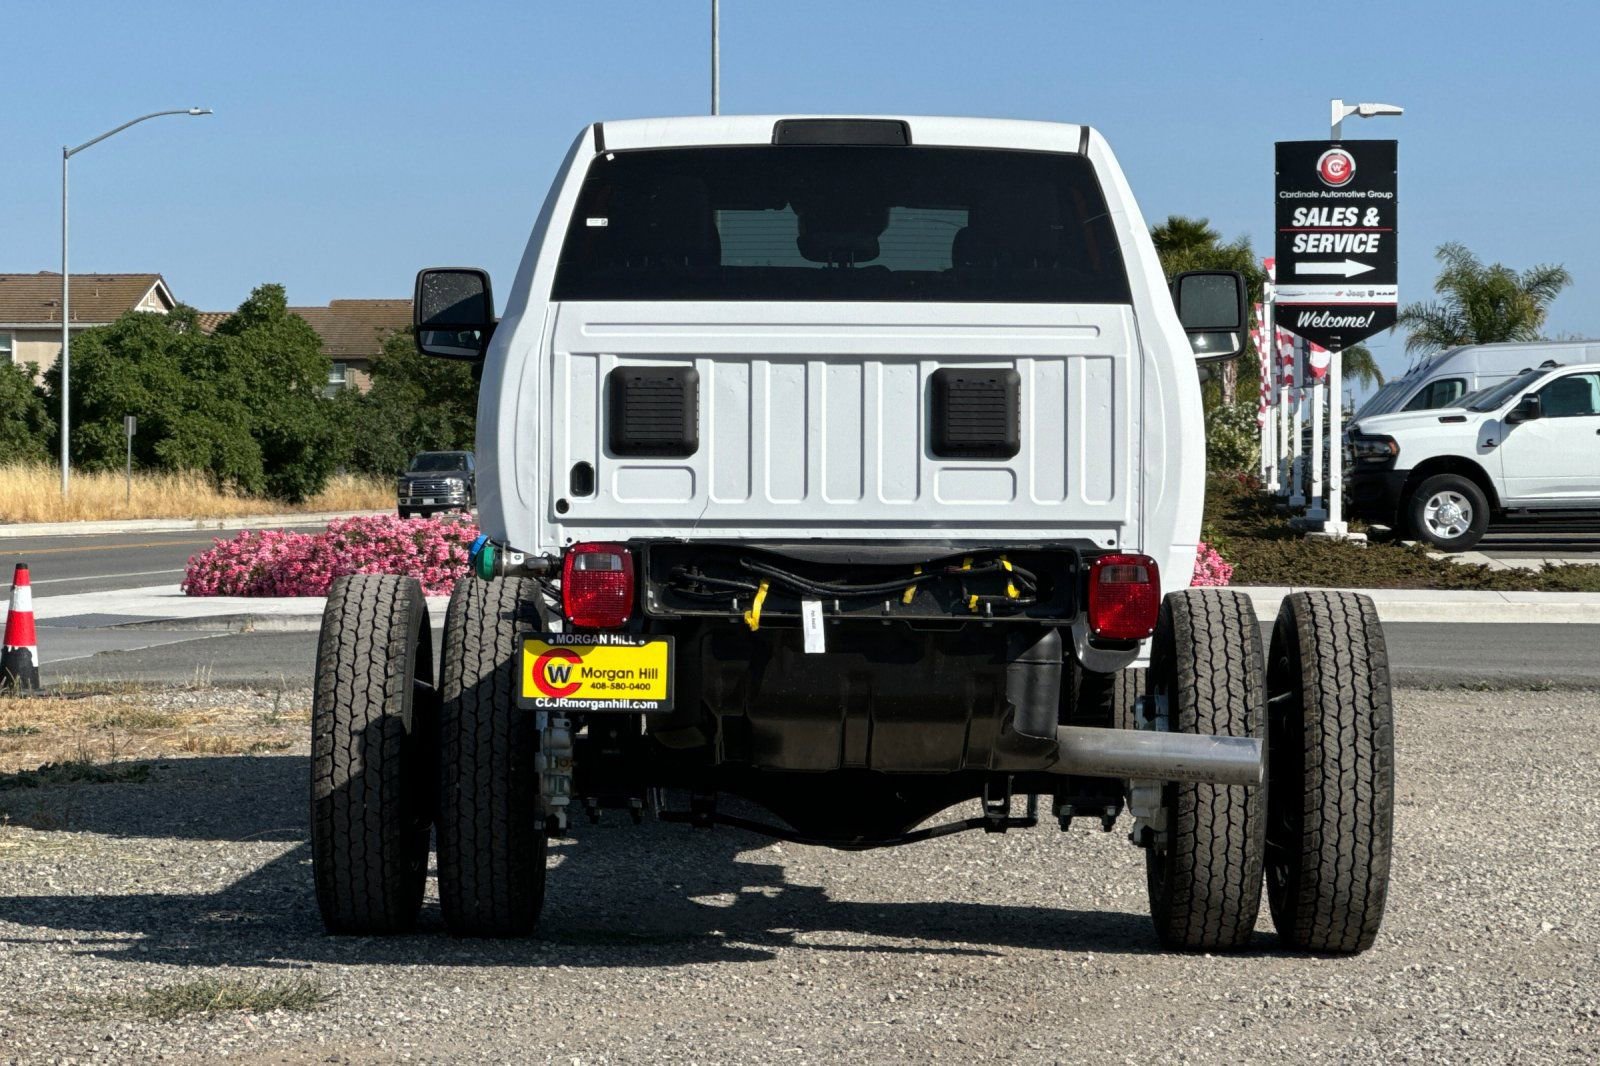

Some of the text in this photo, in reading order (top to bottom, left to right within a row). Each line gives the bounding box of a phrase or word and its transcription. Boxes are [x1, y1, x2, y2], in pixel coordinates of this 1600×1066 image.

[1279, 190, 1394, 200] Cardinale Automotive Group
[1292, 207, 1380, 227] SALES &
[1292, 233, 1380, 253] SERVICE
[1297, 310, 1375, 328] Welcome!
[556, 634, 636, 645] MORGAN HILL
[581, 667, 658, 681] Morgan Hill
[590, 682, 651, 690] 408-580-0400
